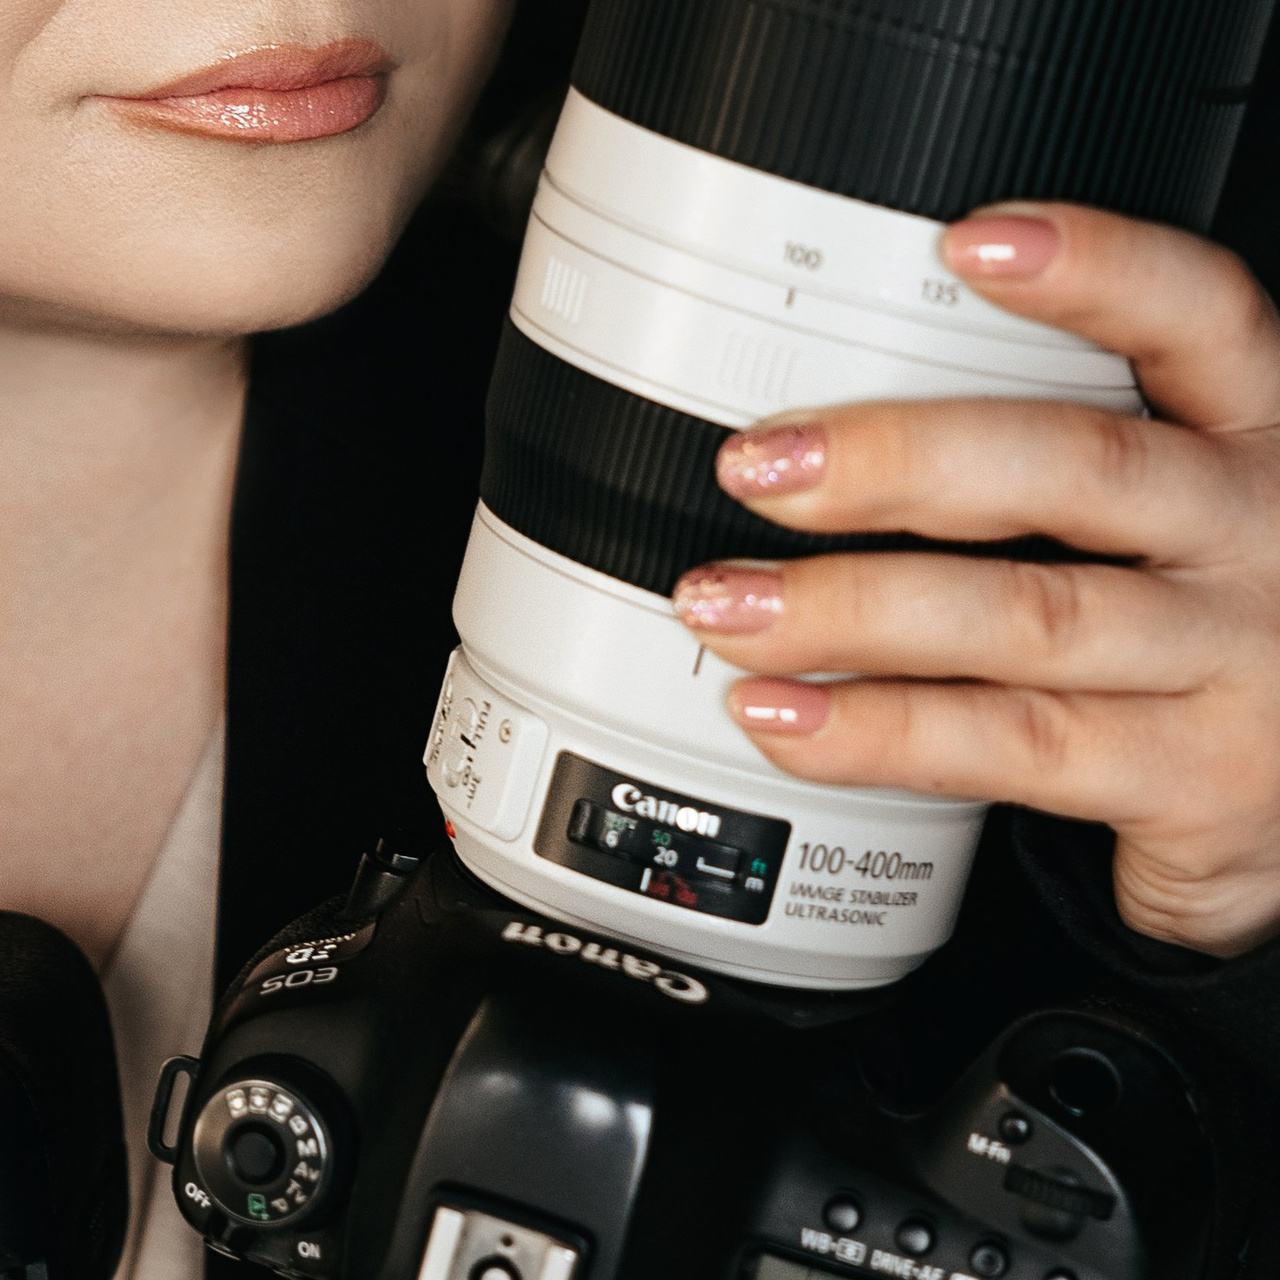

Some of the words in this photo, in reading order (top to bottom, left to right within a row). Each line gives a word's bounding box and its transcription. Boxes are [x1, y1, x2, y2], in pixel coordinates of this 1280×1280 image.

[784, 240, 823, 271] 100
[611, 782, 722, 839] Canon
[653, 846, 680, 868] 20
[798, 841, 934, 881] 100-400mm
[789, 881, 845, 903] IMAGE
[849, 888, 919, 907] STABILIZER
[784, 902, 888, 926] ULTRASONIC
[501, 921, 710, 1005] Canon
[260, 966, 338, 995] EOS
[967, 1132, 1011, 1166] M-Fn
[184, 1181, 212, 1209] OFF
[297, 1241, 321, 1259] ON
